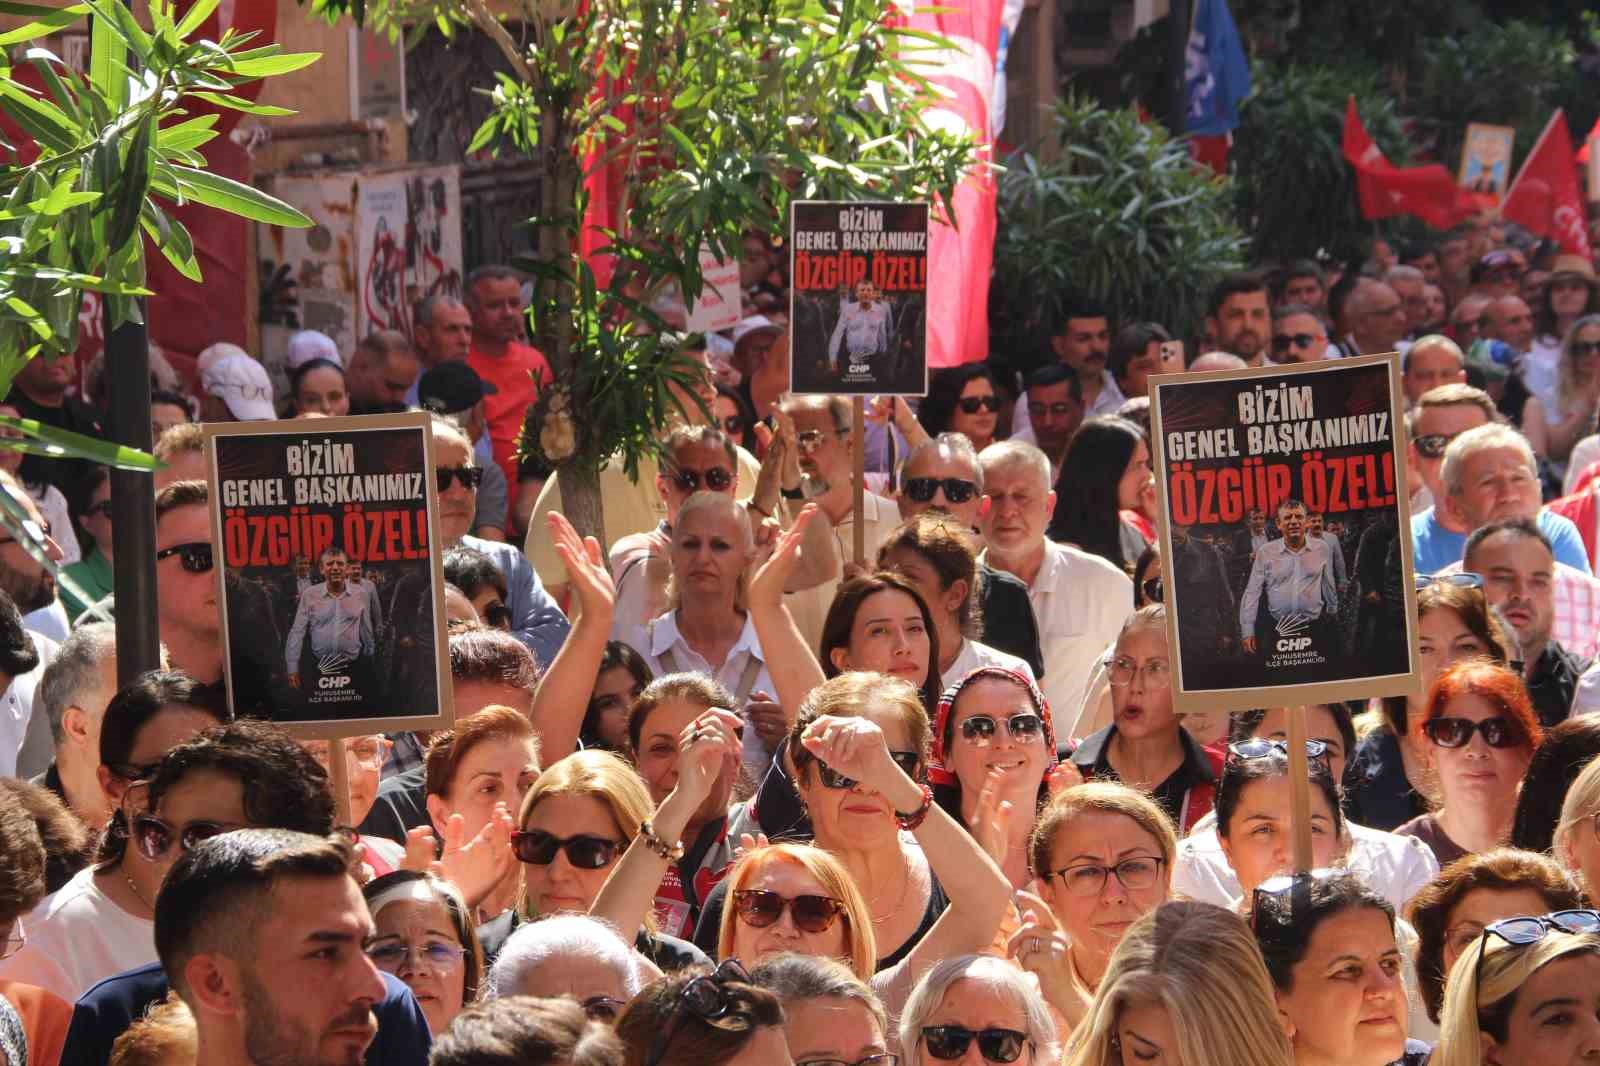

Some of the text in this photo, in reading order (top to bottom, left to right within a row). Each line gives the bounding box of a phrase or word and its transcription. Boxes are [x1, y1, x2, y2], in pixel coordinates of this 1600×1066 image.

[839, 206, 883, 231] BİZİM
[796, 231, 926, 254] GENEL BAŞKANIMIZ
[795, 250, 927, 291] ÖZGÜR ÖZEL!
[849, 364, 870, 373] CHP
[1238, 382, 1314, 425] BİZİM
[1168, 412, 1390, 461] GENEL BAŞKANIMIZ
[286, 439, 355, 476] BİZİM
[223, 472, 424, 507] GENEL BAŞKANIMIZ
[1170, 451, 1396, 526] ÖZGÜR ÖZEL!
[224, 503, 429, 568] ÖZGÜR ÖZEL!
[1276, 637, 1312, 651] CHP
[318, 676, 351, 688] CHP
